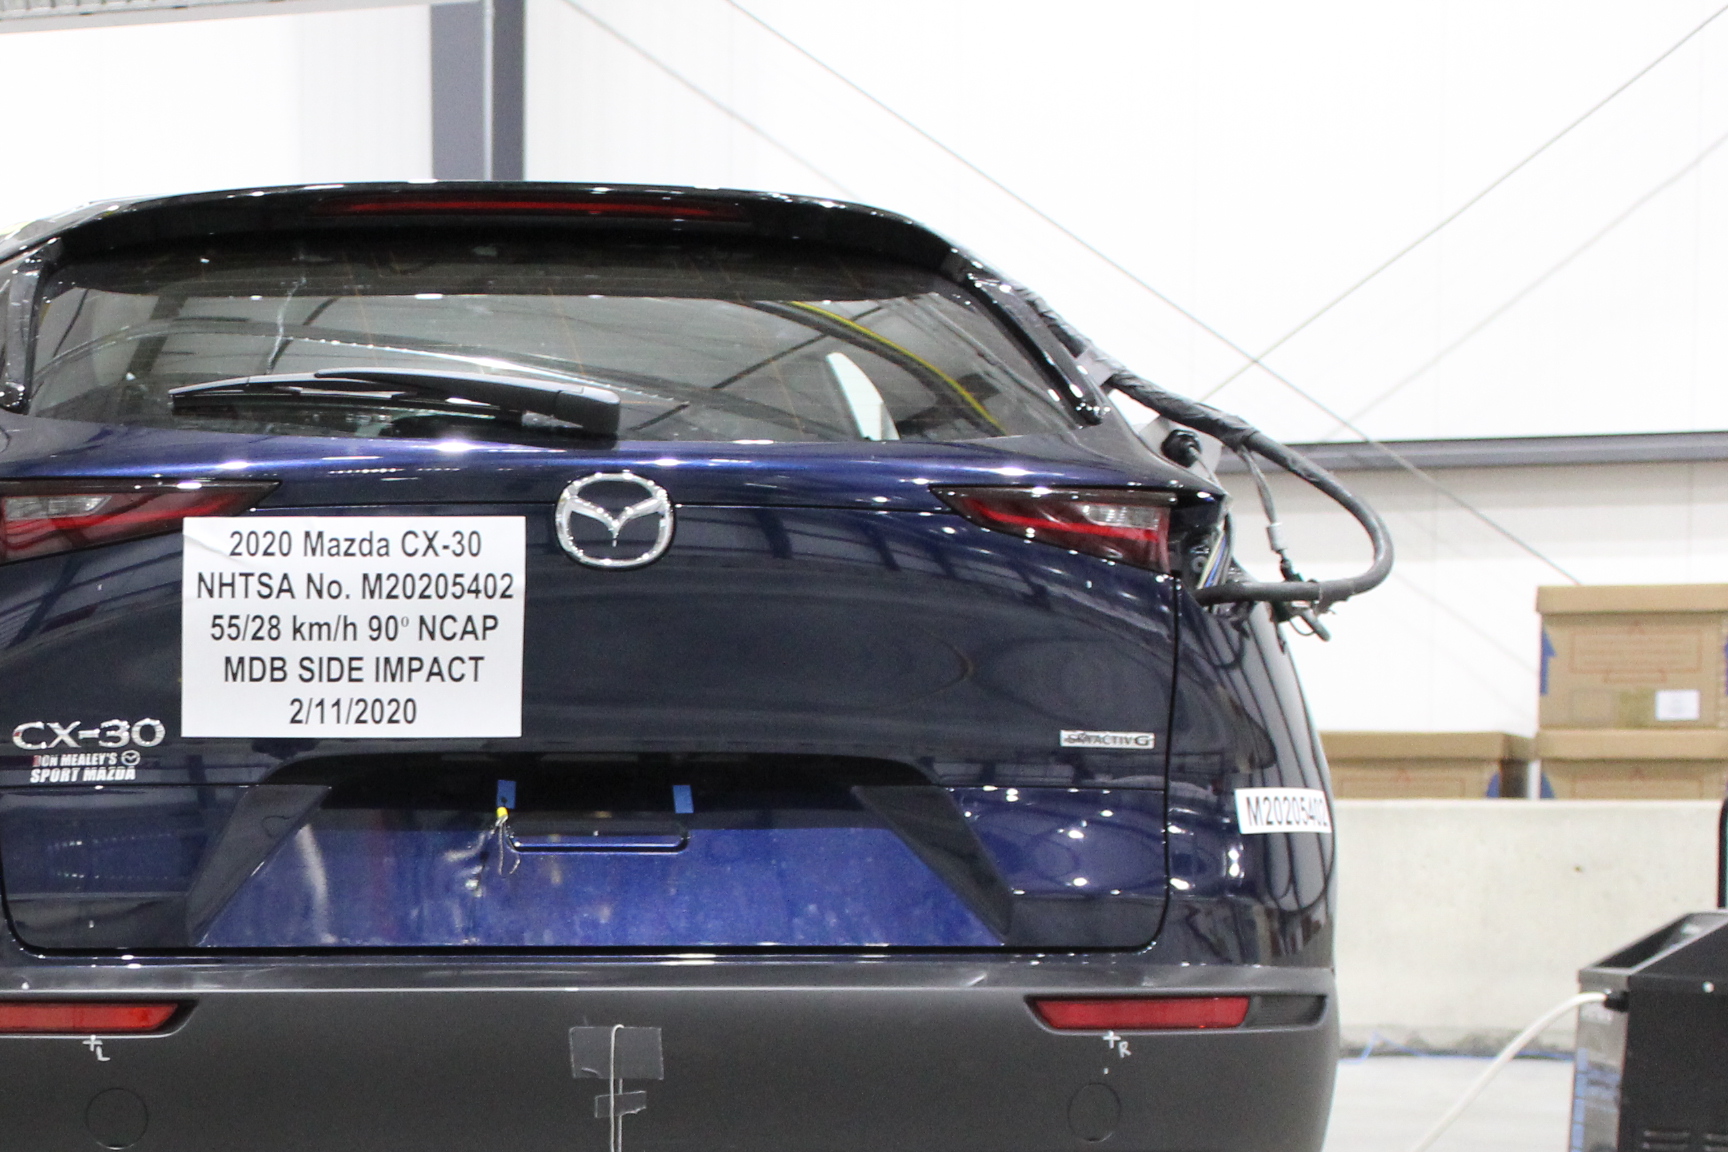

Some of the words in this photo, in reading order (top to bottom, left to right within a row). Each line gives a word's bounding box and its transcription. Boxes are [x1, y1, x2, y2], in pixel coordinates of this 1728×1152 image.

[230, 531, 291, 556] 2020
[305, 531, 389, 556] Mazda
[402, 531, 480, 557] CX-30
[198, 573, 295, 599] NHTSA
[307, 573, 349, 599] No.
[363, 573, 513, 599] M20205402
[212, 615, 280, 641] 55/28
[293, 615, 356, 640] km/h
[419, 615, 498, 641] NCAP
[225, 657, 287, 682] MDB
[299, 657, 363, 682] SIDE
[376, 656, 484, 682] IMPACT
[290, 698, 416, 724] 2/11/2020
[12, 717, 166, 749] CX-30
[60, 752, 118, 766] MEALEY'S
[30, 767, 80, 783] SPORT
[82, 767, 136, 782] MAZDA
[1118, 1040, 1132, 1058] R
